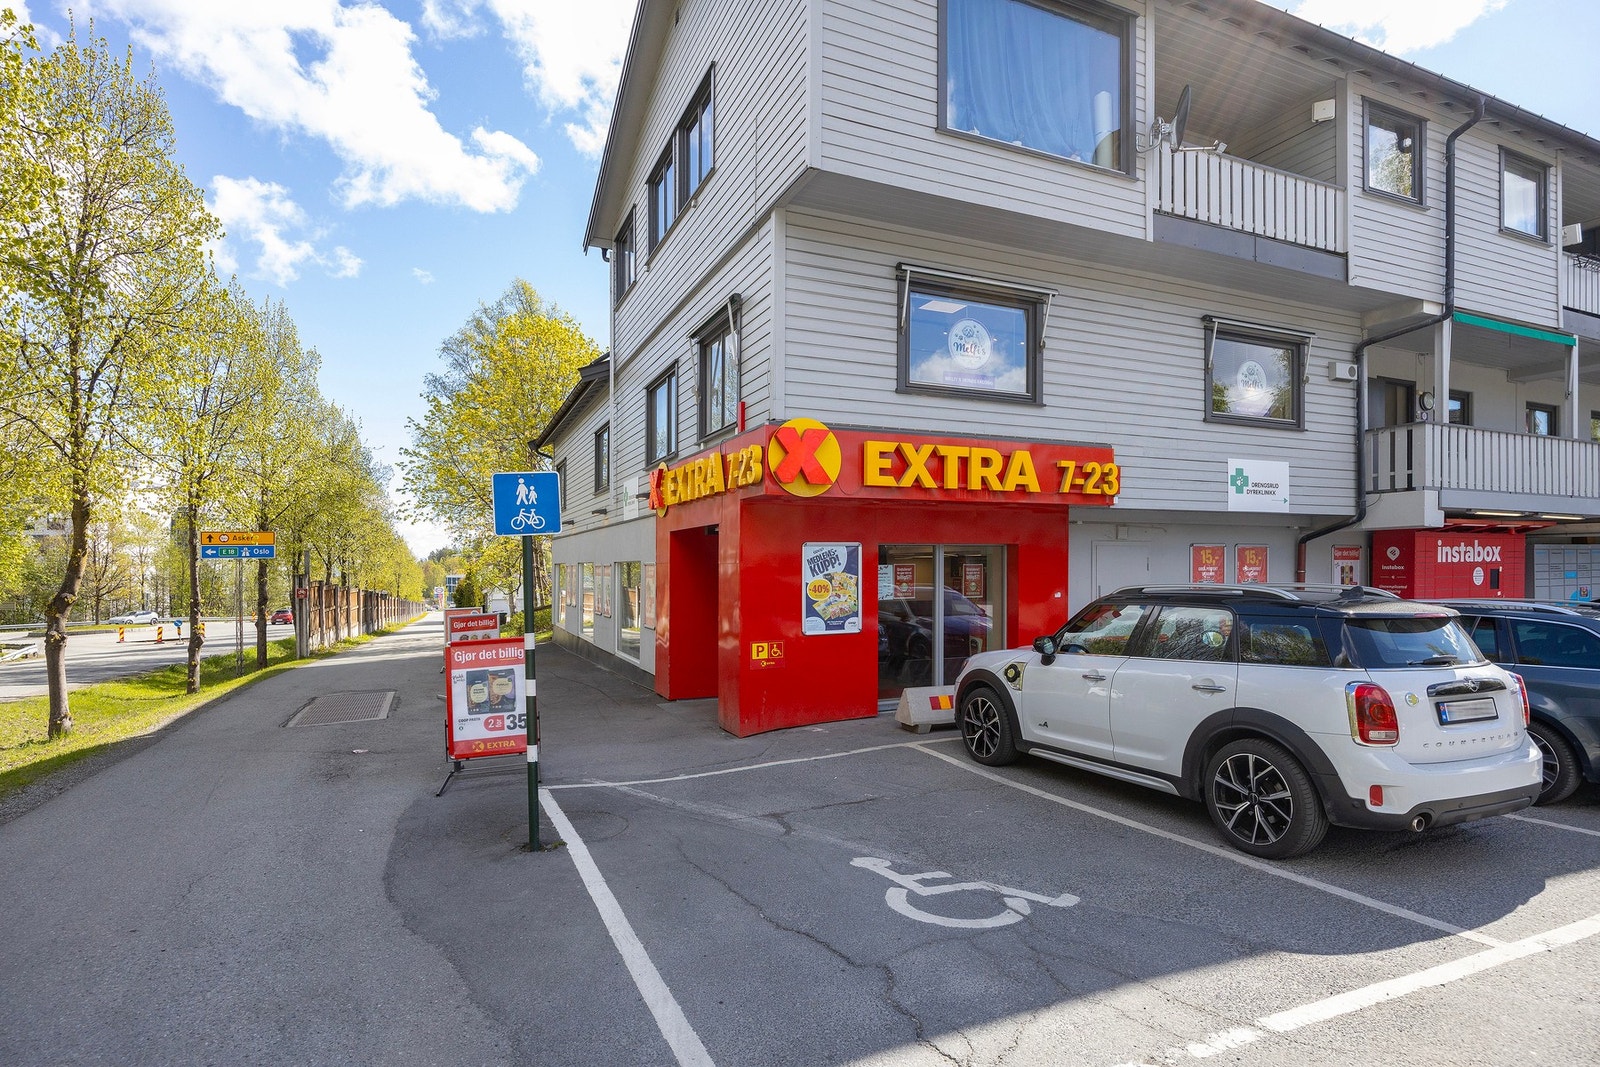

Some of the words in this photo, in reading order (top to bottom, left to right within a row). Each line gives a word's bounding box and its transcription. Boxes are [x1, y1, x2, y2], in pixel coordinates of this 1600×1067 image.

[666, 451, 726, 506] EXTRA
[726, 444, 763, 490] 7-23
[864, 440, 1041, 493] EXTRA
[1056, 460, 1120, 496] 7-23
[806, 548, 838, 566] MEDLEMS-
[1437, 539, 1502, 563] instabox
[809, 554, 842, 578] KUPP!
[809, 584, 830, 594] -40%
[453, 621, 467, 629] Gjør
[454, 650, 477, 664] Gjør
[479, 649, 497, 660] det
[756, 645, 765, 658] P
[488, 718, 495, 728] 2
[487, 740, 516, 749] EXTRA
